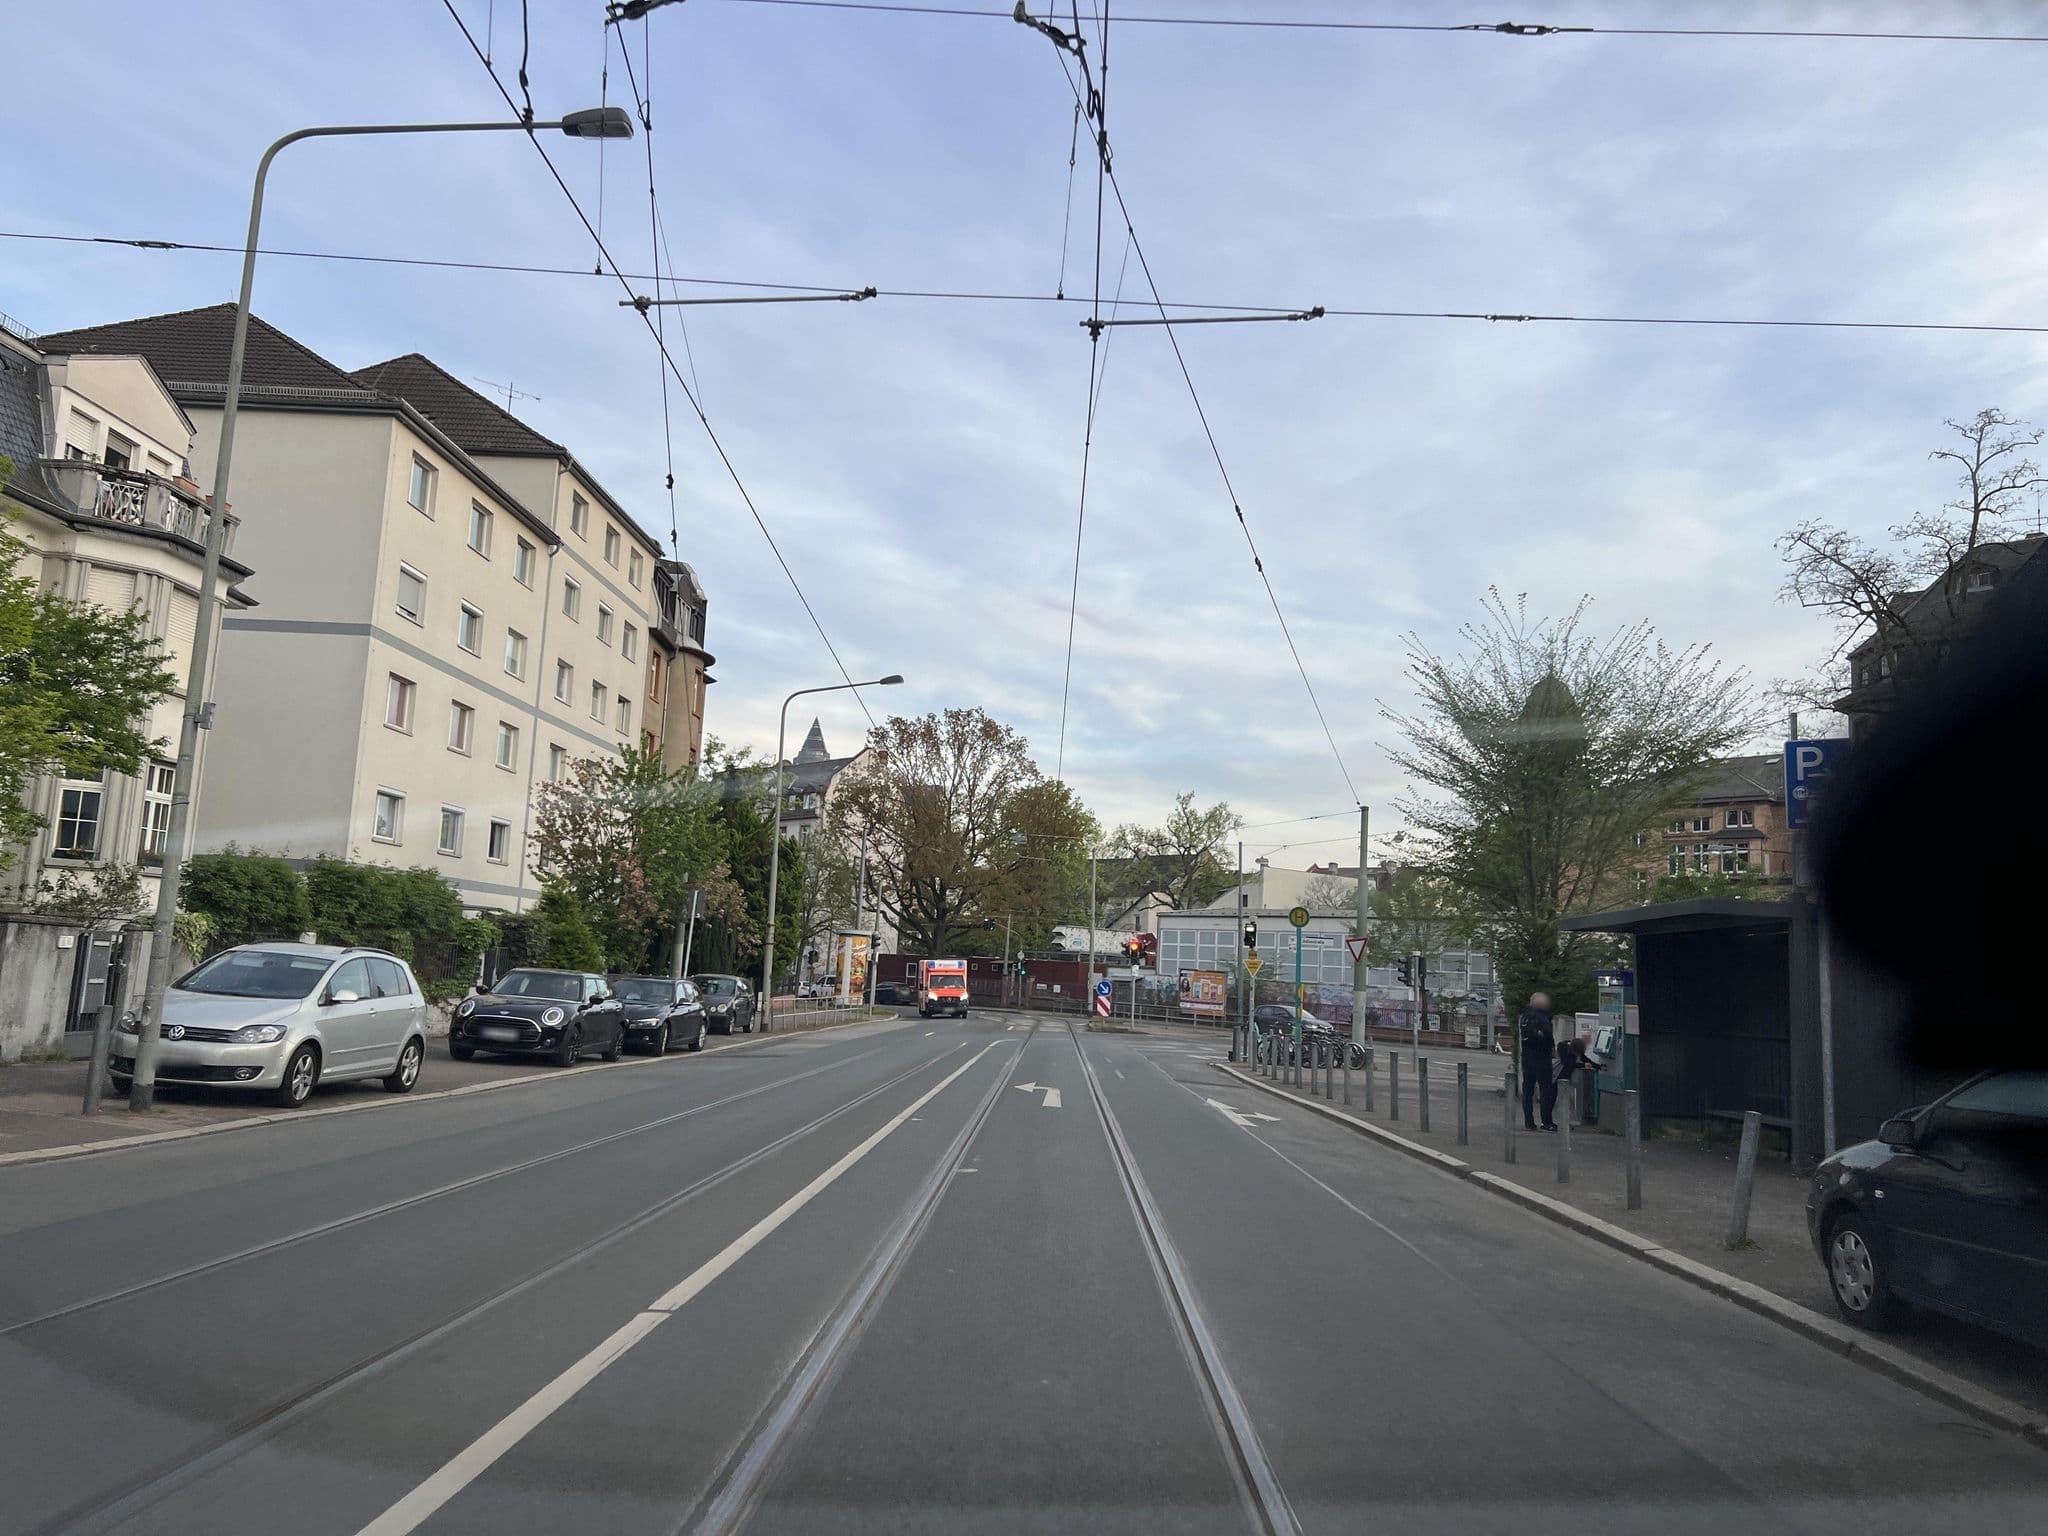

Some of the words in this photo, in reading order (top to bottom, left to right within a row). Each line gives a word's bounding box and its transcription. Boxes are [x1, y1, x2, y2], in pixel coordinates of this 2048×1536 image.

[1796, 747, 1824, 781] P
[1294, 911, 1305, 923] H
[168, 1025, 185, 1041] VW
